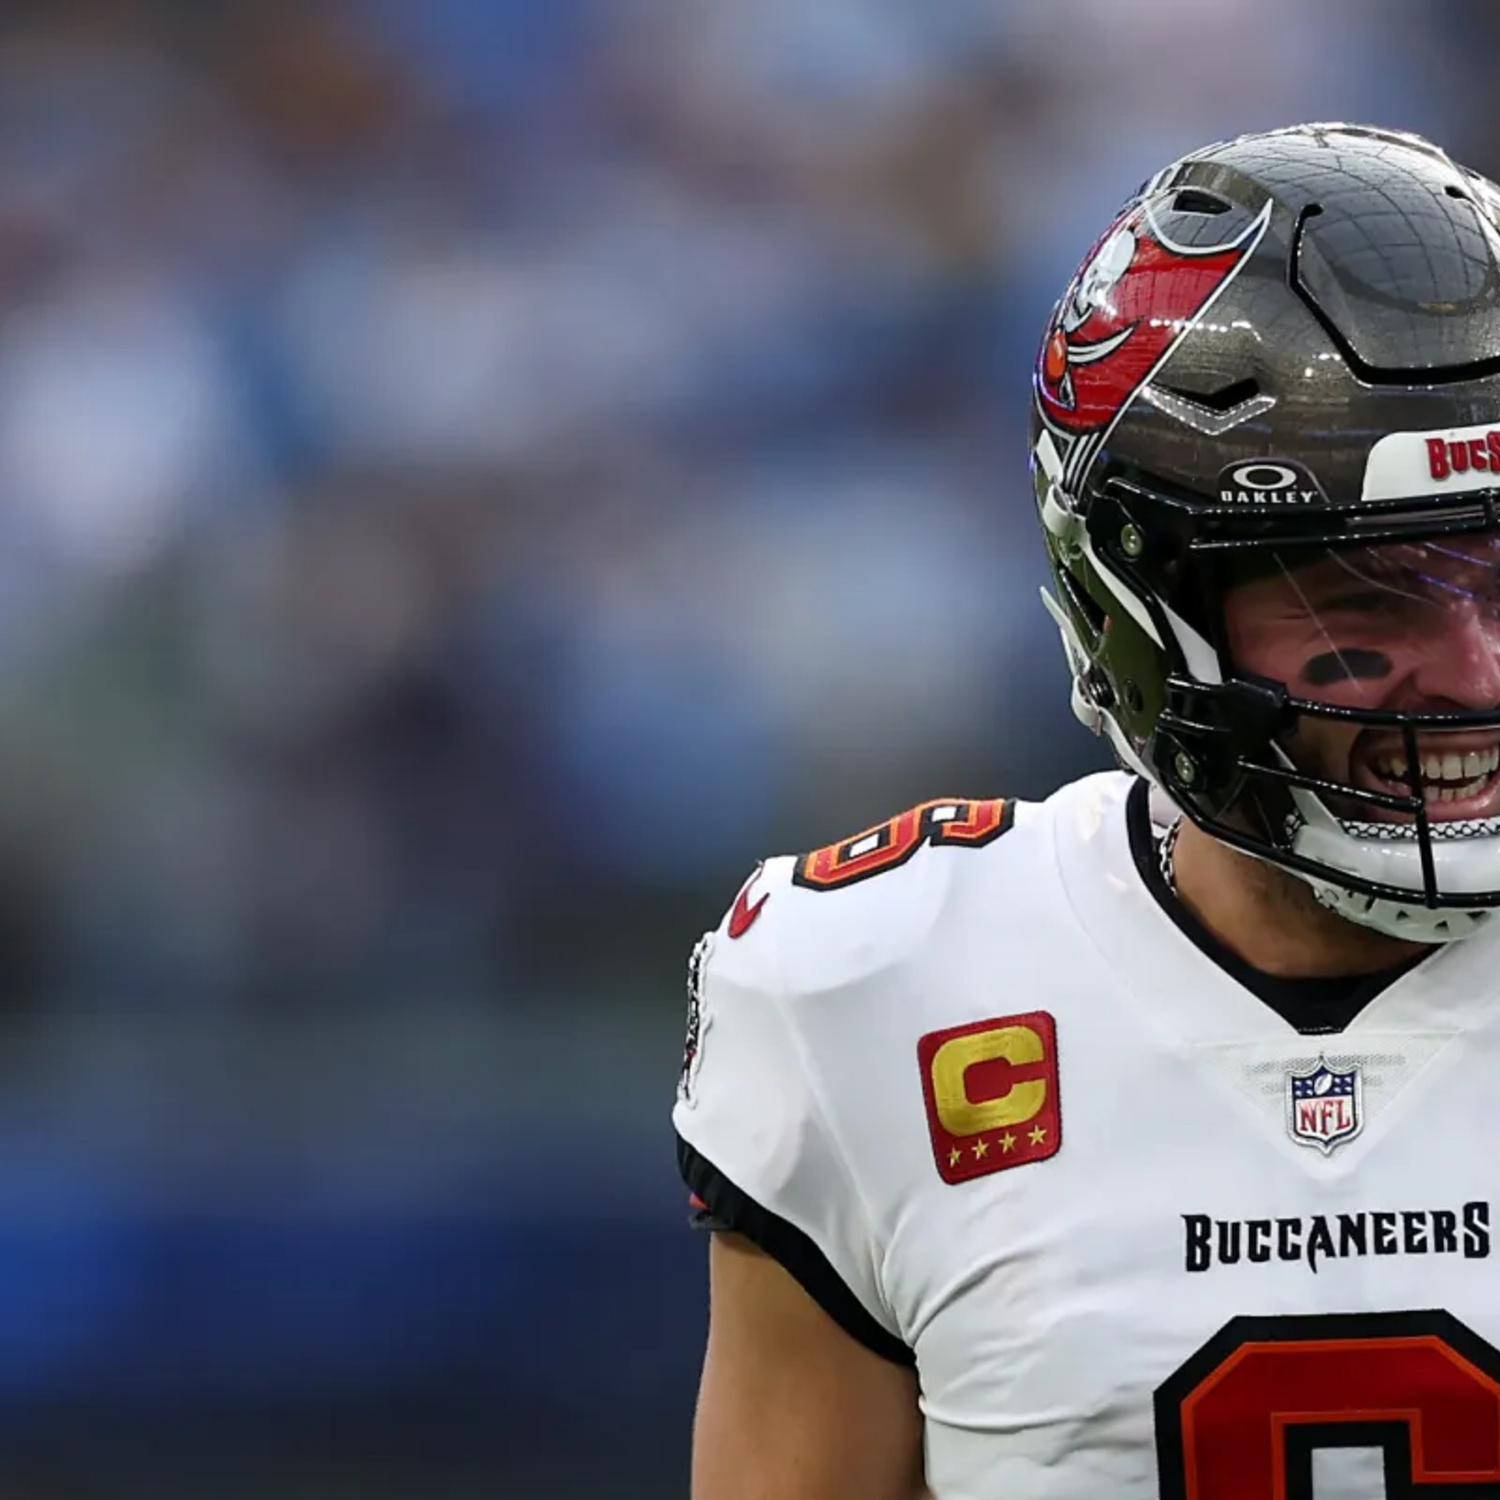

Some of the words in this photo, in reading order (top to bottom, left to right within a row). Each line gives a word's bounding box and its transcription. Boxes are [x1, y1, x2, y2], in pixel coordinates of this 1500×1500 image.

[1220, 490, 1314, 503] OAKLEY
[792, 798, 1014, 891] 6
[931, 1025, 1046, 1136] C
[1300, 1100, 1350, 1135] NFL
